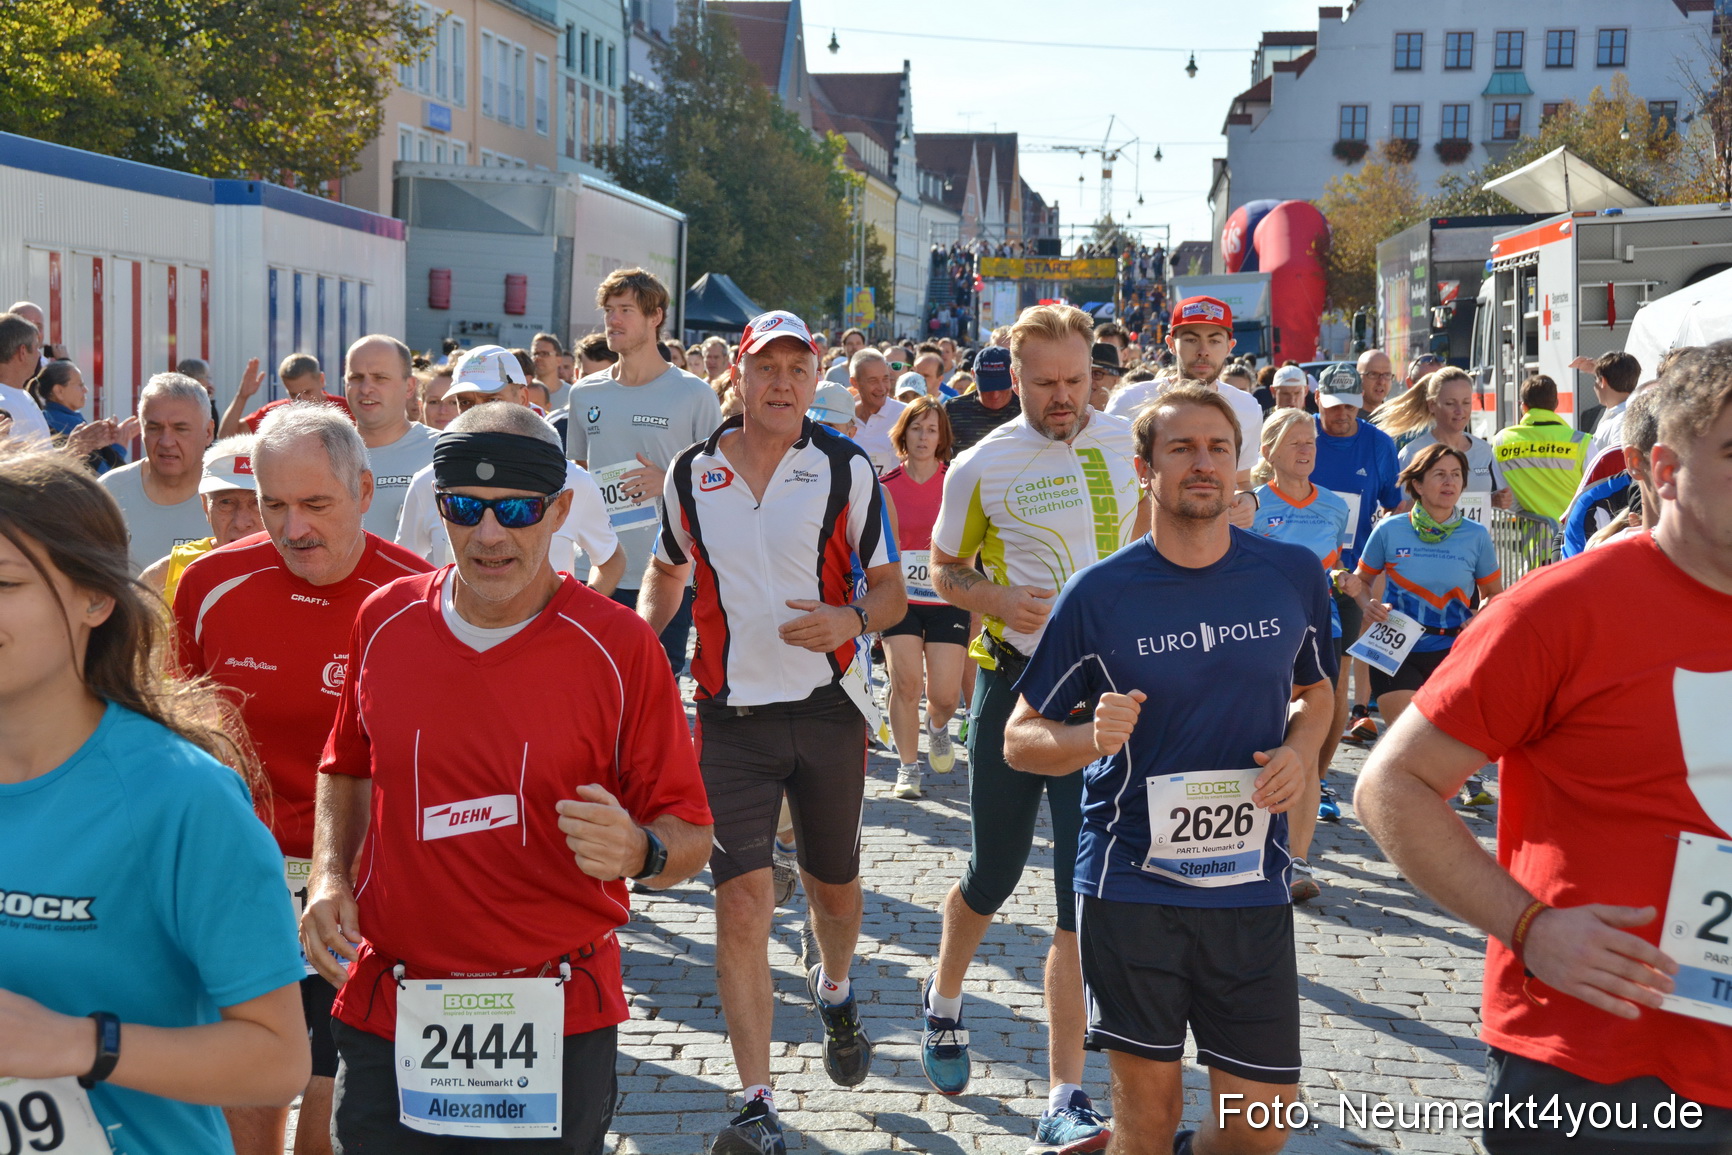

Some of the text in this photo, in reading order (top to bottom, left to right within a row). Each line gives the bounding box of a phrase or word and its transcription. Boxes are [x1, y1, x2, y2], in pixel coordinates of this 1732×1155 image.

[1024, 262, 1071, 274] START
[632, 415, 669, 426] BOCK
[1501, 443, 1571, 457] Org.-Leiter
[701, 470, 725, 484] tkn
[1014, 474, 1077, 494] cadion
[1017, 487, 1079, 506] Rothsee
[1018, 498, 1084, 517] Triathlon
[907, 565, 931, 581] 20
[291, 593, 322, 604] CRAFT
[1137, 618, 1281, 655] EURO POLES
[1369, 622, 1407, 650] 2359
[1185, 781, 1240, 795] BOCK
[449, 806, 492, 827] DEHN
[1170, 802, 1254, 843] 2626
[1202, 844, 1235, 853] Neumarkt
[1180, 860, 1236, 877] Stephan
[23, 922, 51, 931] smart
[54, 923, 98, 932] concepts
[1675, 924, 1683, 935] B
[444, 993, 515, 1010] BOCK
[421, 1022, 538, 1069] 2444
[404, 1059, 411, 1068] B
[430, 1077, 514, 1087] PARTL Neumarkt
[428, 1098, 527, 1118] Alexander
